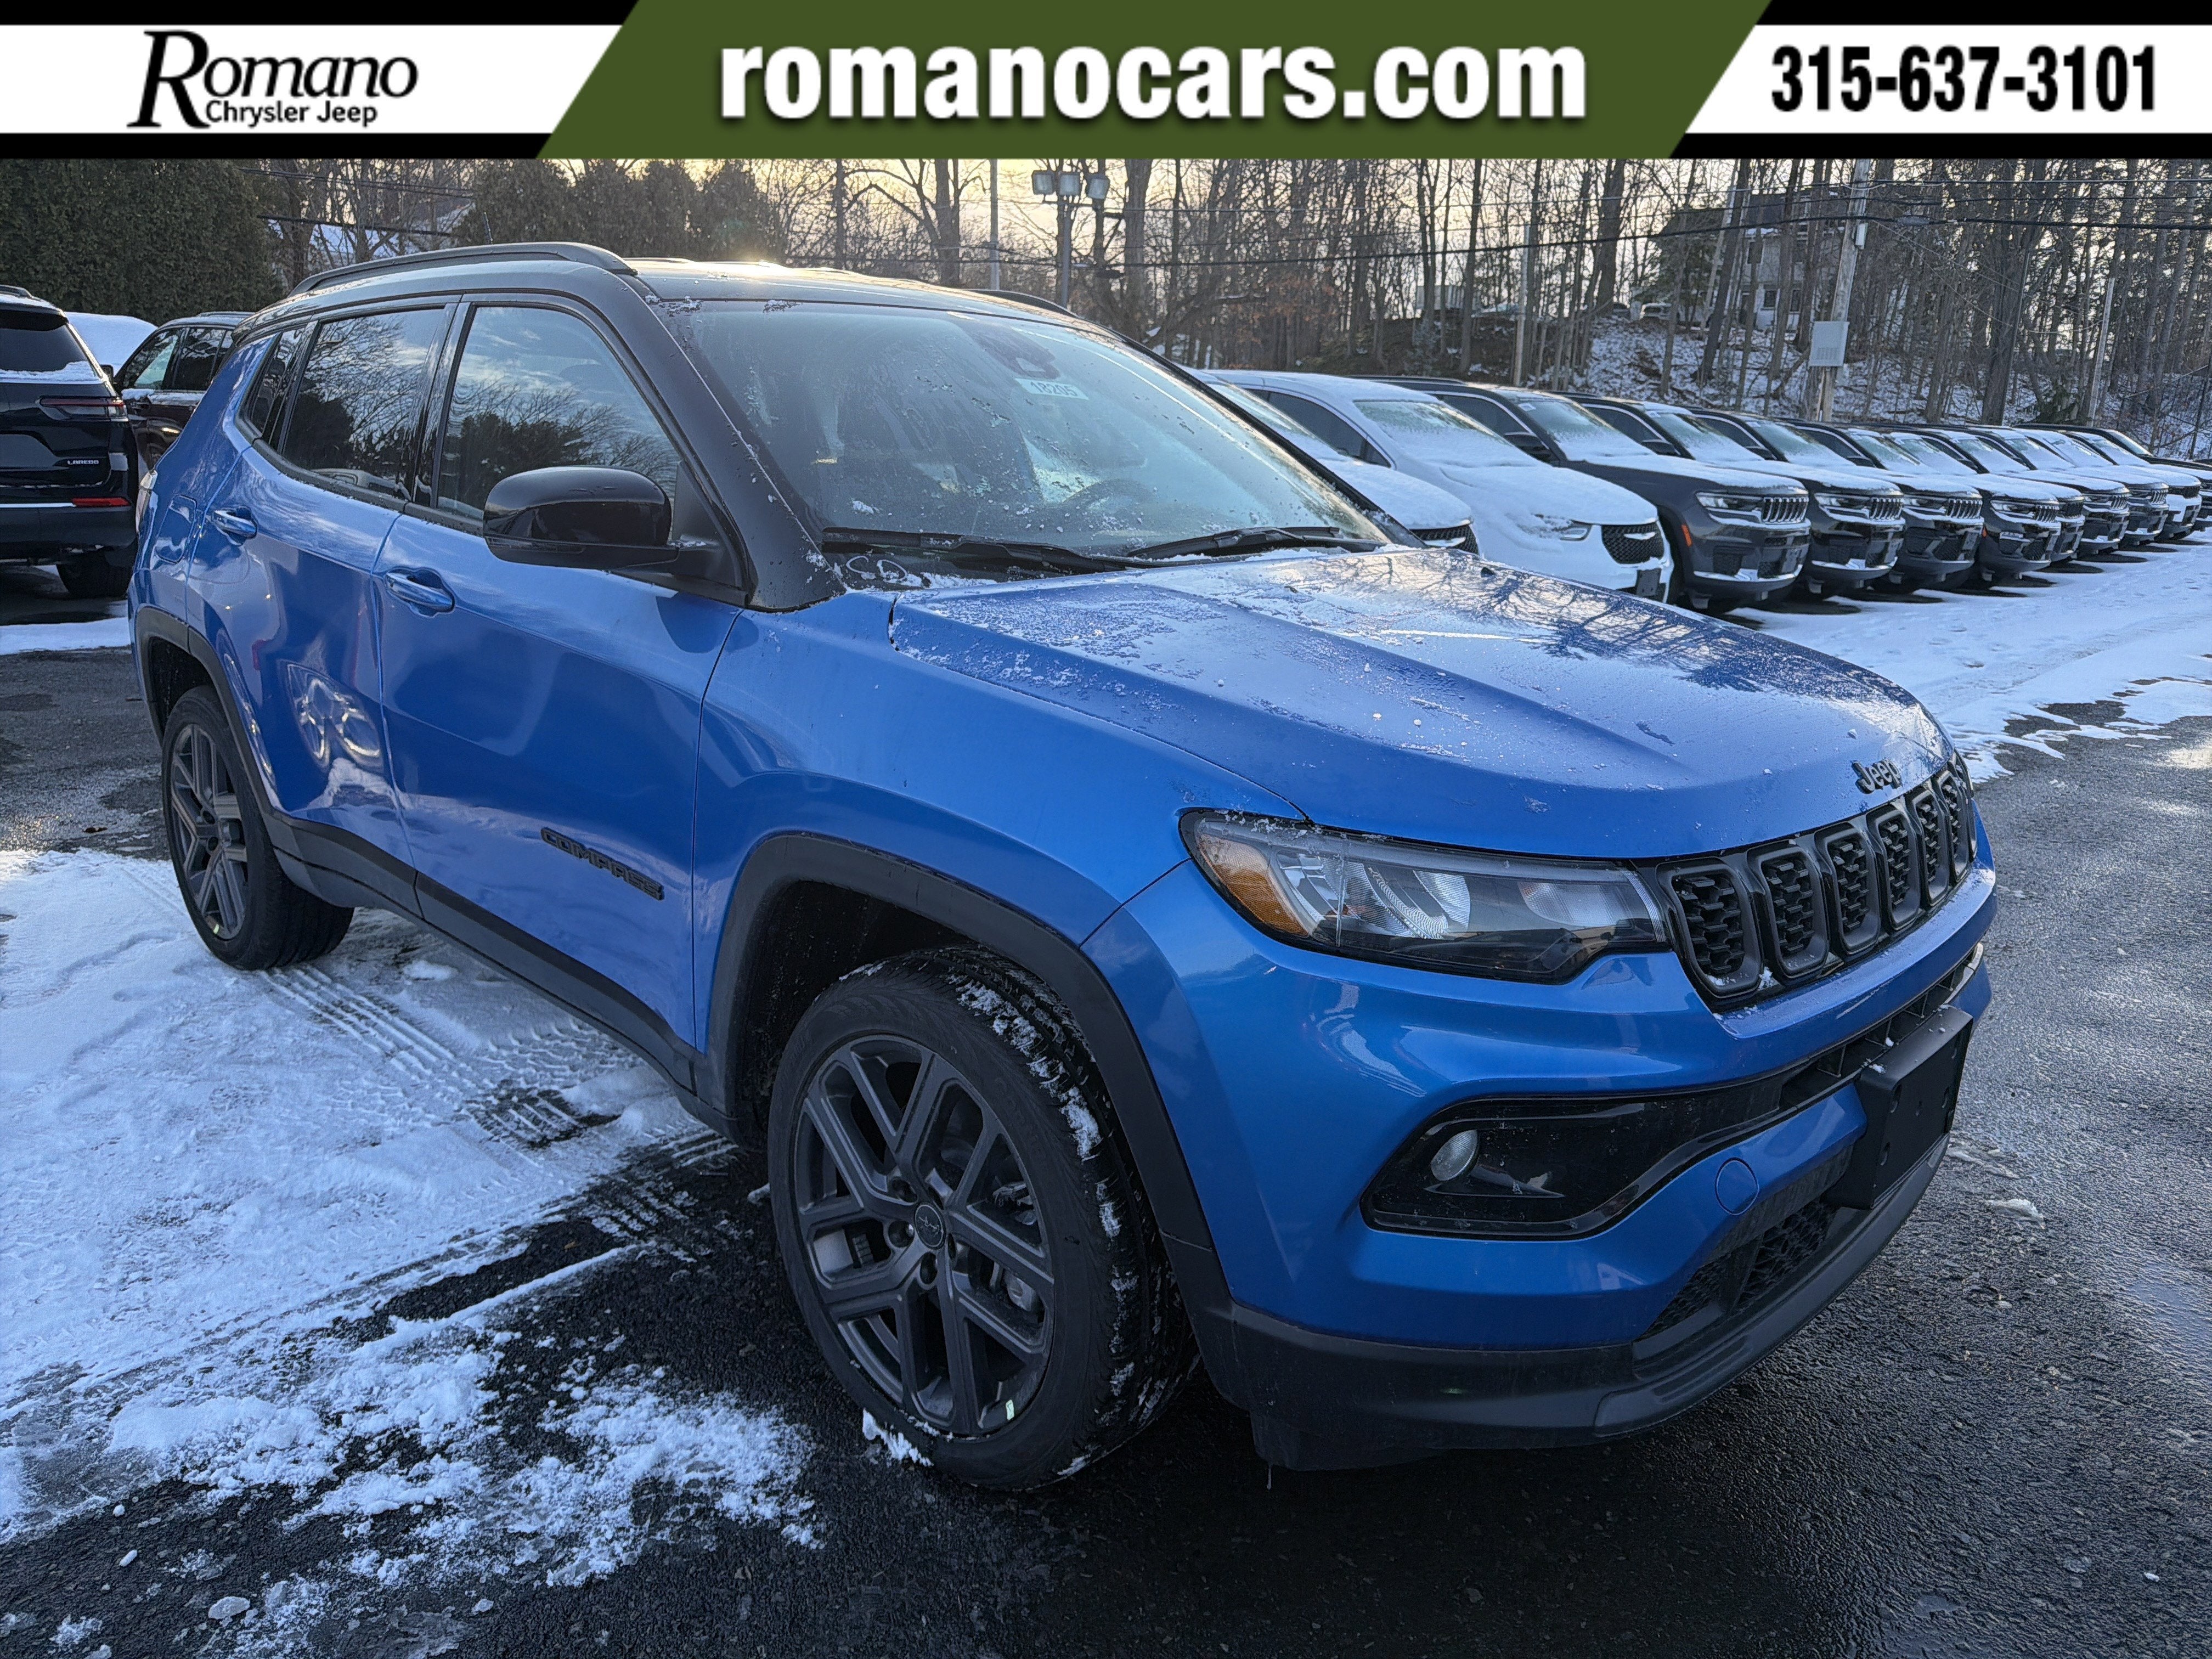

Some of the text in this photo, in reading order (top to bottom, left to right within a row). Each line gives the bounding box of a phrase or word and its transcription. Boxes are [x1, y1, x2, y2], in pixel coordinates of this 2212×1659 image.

[1030, 381, 1078, 397] 18205
[1851, 758, 1903, 794] Jeep
[540, 826, 665, 901] COMPASS
